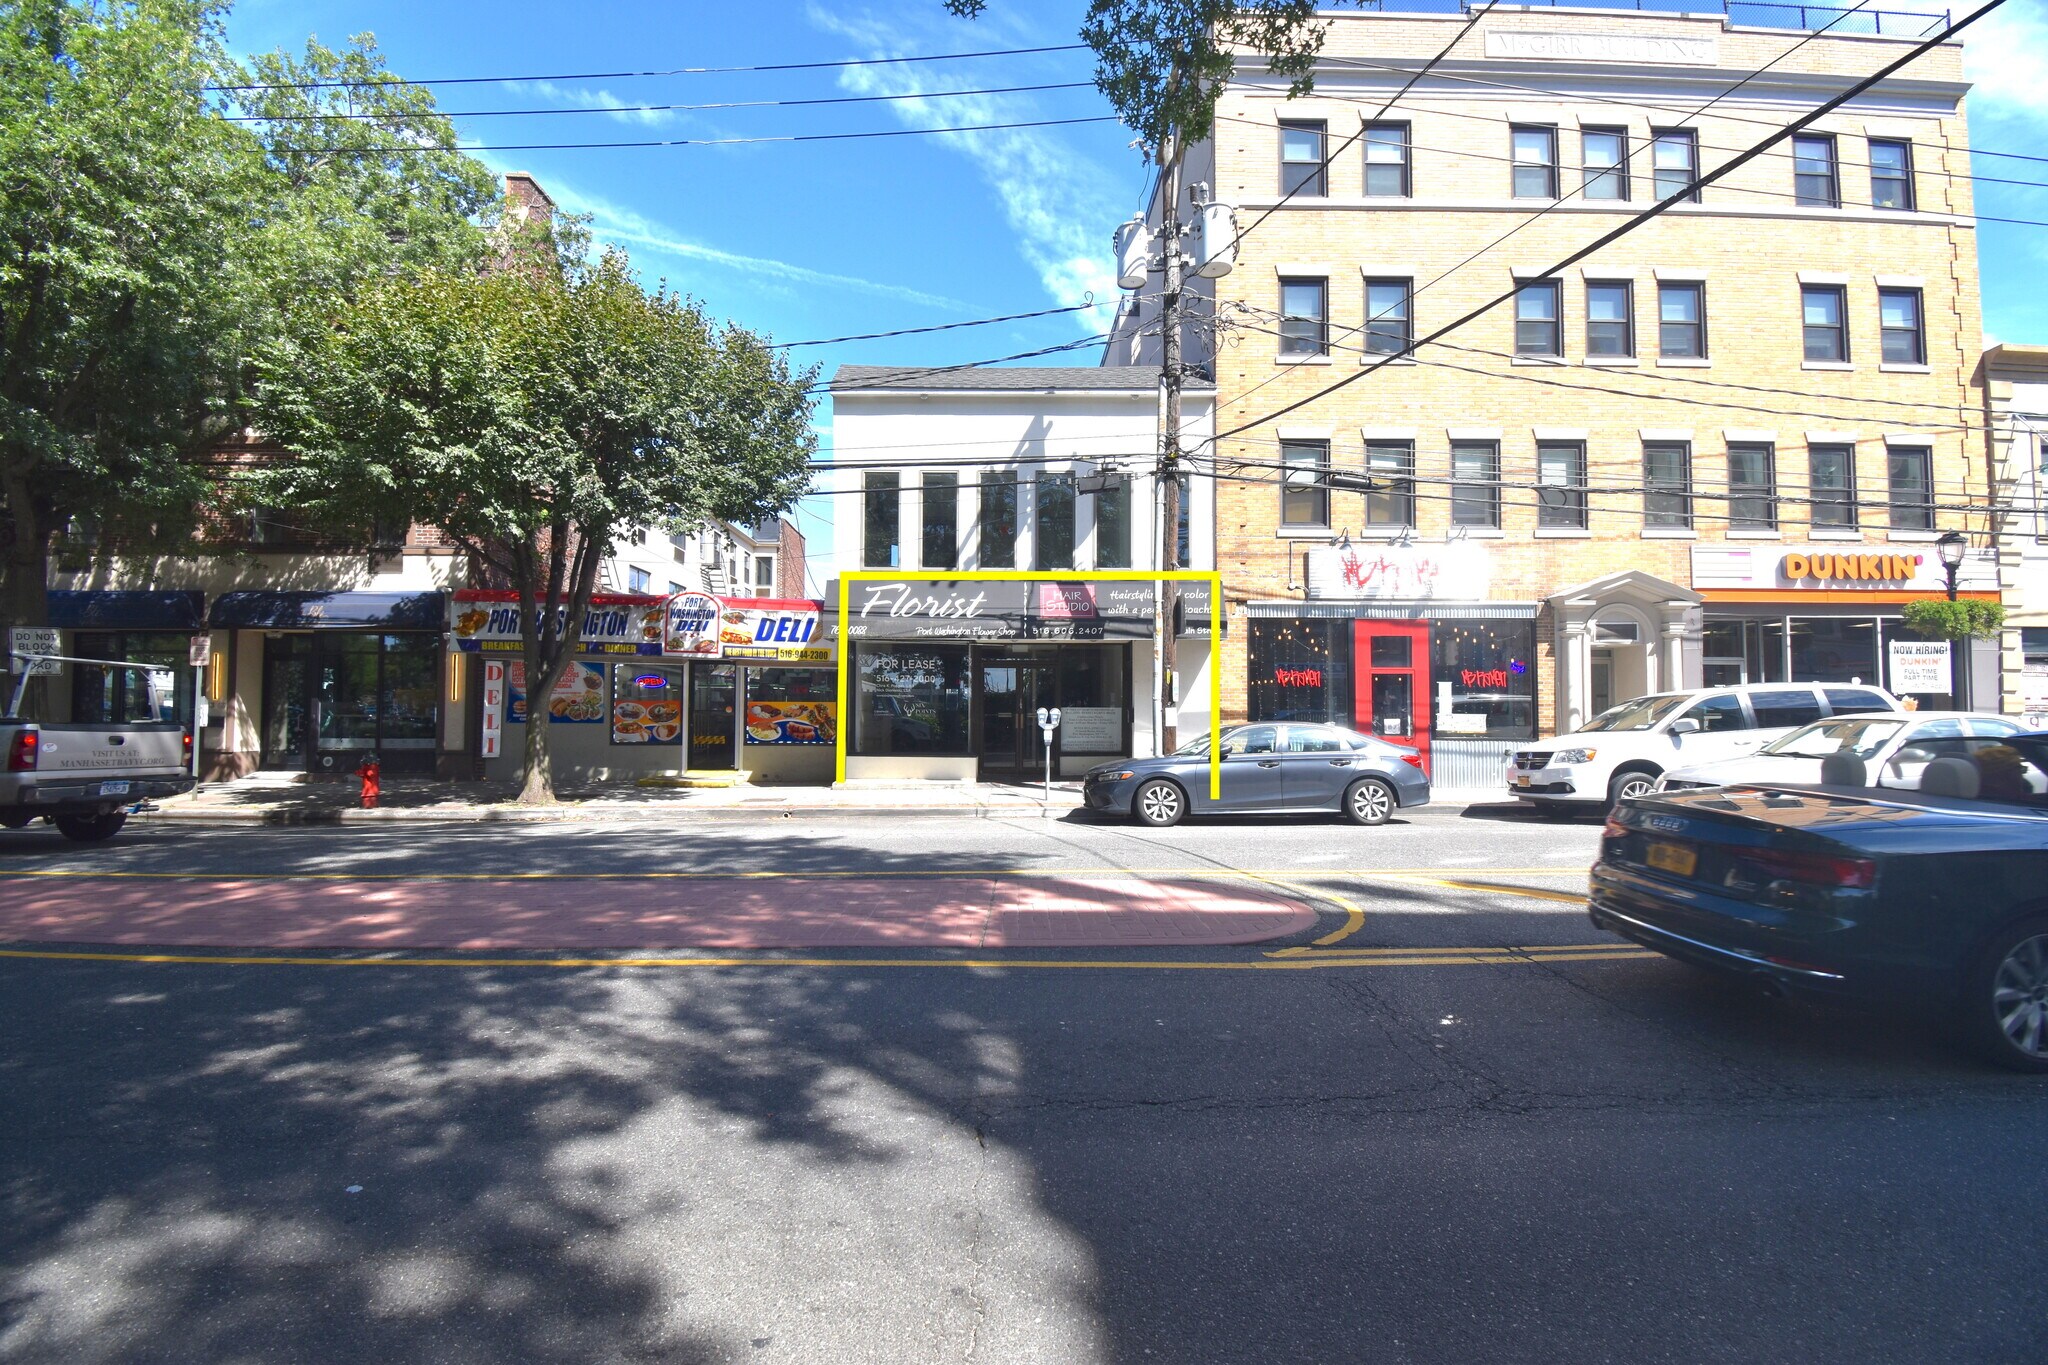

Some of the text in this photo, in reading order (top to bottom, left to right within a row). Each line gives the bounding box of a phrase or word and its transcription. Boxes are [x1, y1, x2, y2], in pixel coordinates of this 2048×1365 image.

[1785, 553, 1923, 580] DUNKIN'
[1053, 590, 1082, 600] HAIR
[1110, 588, 1154, 602] Hairstylin
[1184, 588, 1209, 599] color
[684, 597, 704, 607] PORT
[861, 583, 987, 619] Florist
[1046, 601, 1090, 612] STUDIO
[670, 608, 716, 620] WASHINGTON
[1108, 603, 1129, 614] with
[1132, 606, 1138, 614] a
[487, 608, 523, 634] POR
[676, 620, 710, 632] DELI
[754, 616, 816, 643] DELI
[916, 625, 1016, 638] Port Washington Flower Shop
[1033, 627, 1104, 635] 516.606.2407
[16, 633, 57, 641] DO NOT
[18, 643, 55, 651] BLOCK
[481, 641, 525, 651] BREAKFAS
[1893, 645, 1948, 655] NOW HIRING!
[779, 648, 828, 660] 516-944-2300
[876, 659, 935, 669] FOR LEASE
[635, 677, 664, 686] OPEN
[92, 750, 114, 758] VISIT
